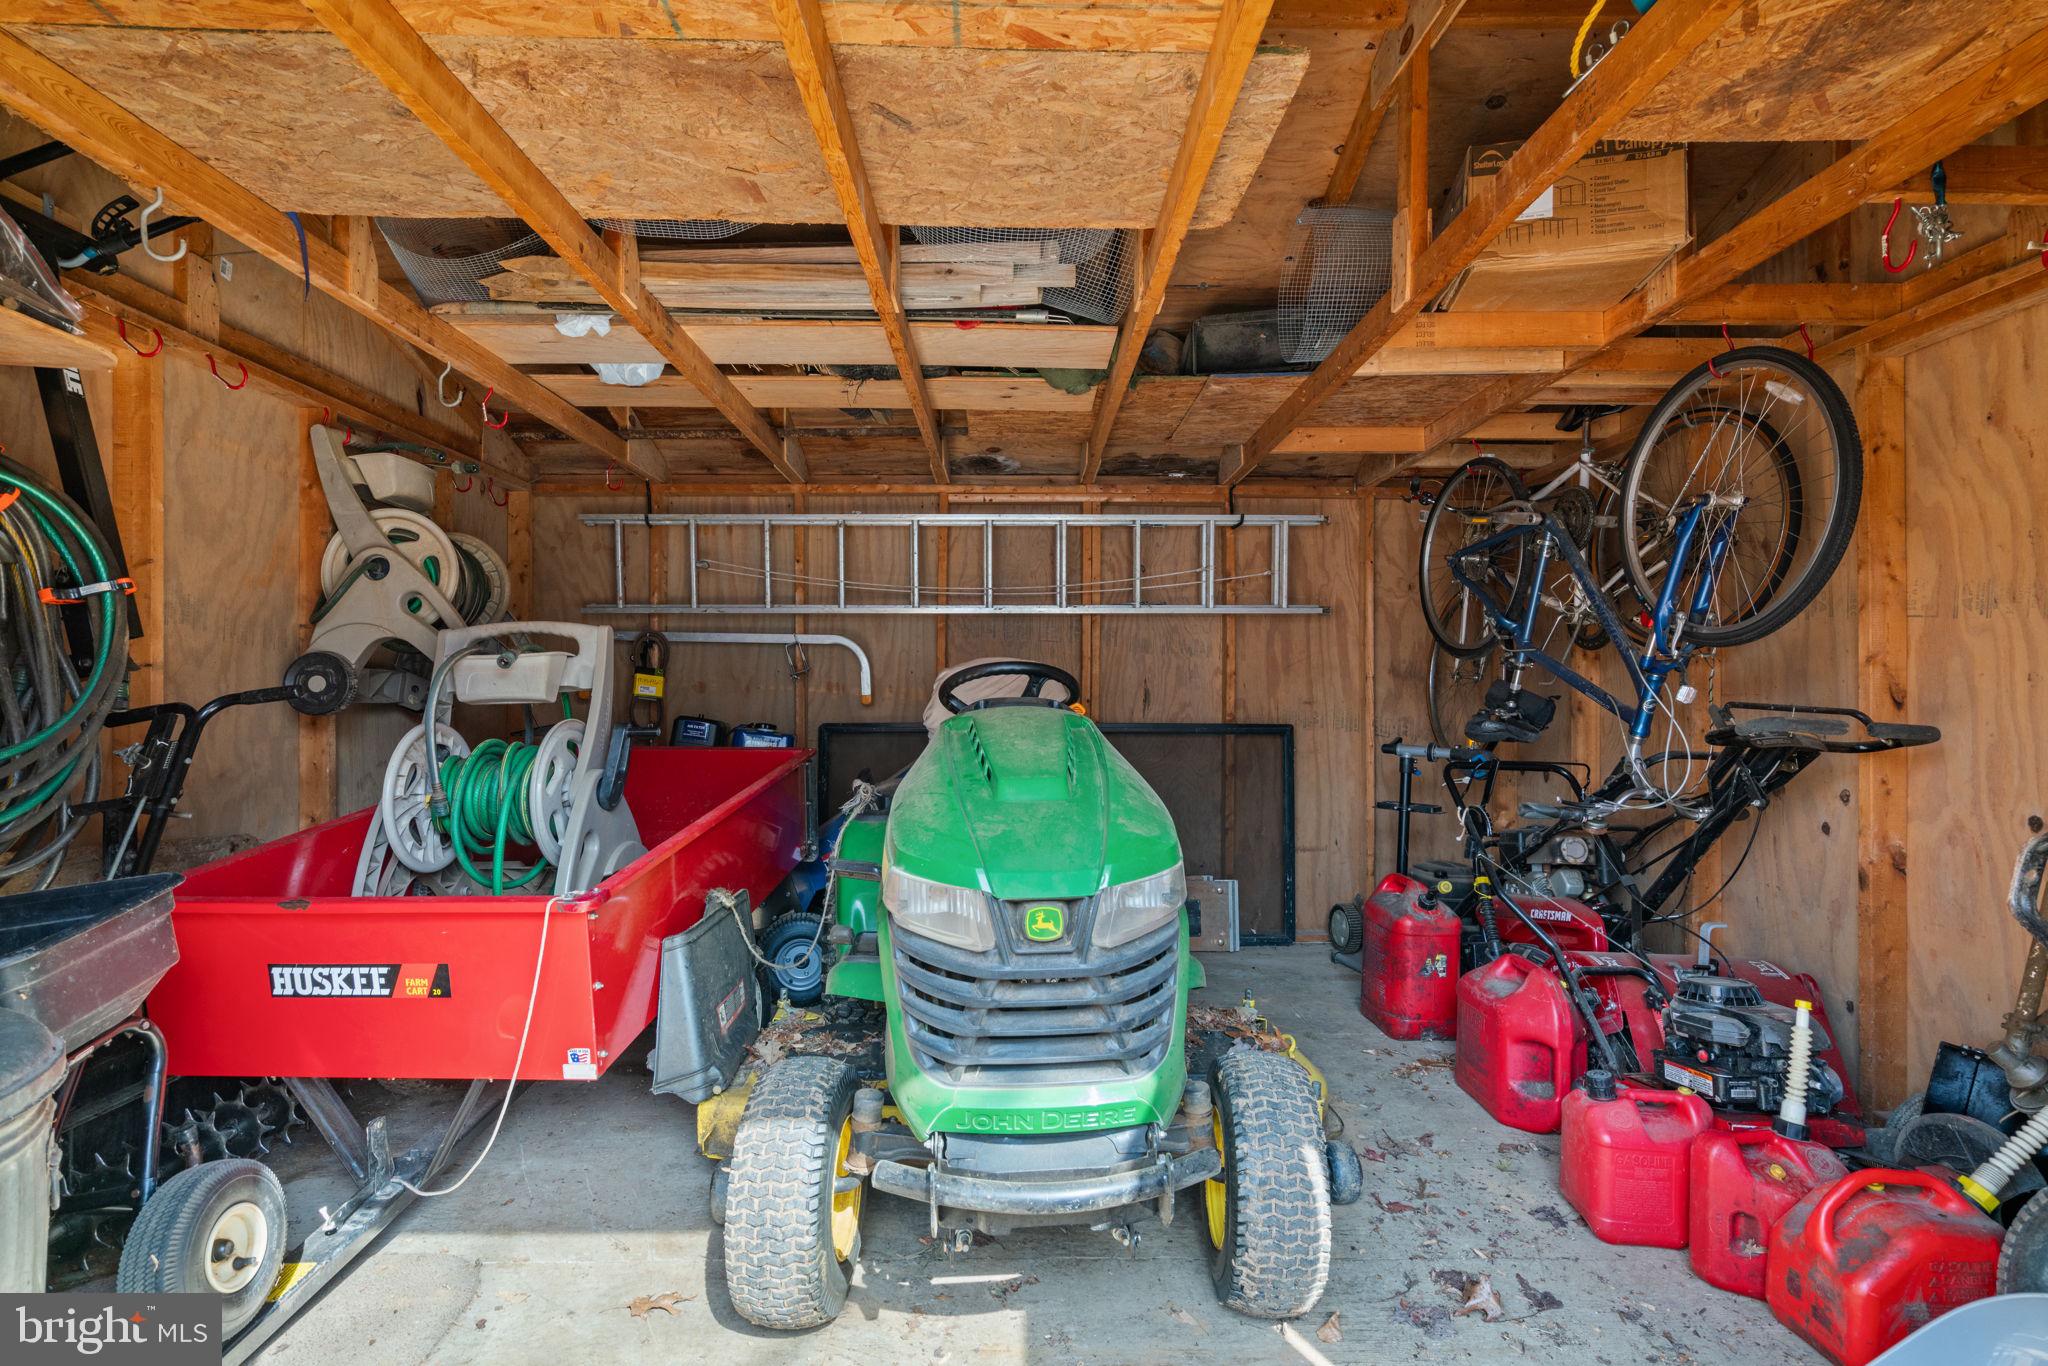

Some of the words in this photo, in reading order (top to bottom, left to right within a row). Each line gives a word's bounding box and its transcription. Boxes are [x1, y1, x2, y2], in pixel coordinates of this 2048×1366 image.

[1530, 908, 1572, 922] CRAFTSMAN
[270, 966, 391, 996] HUSKEE
[405, 978, 428, 987] FARM
[406, 987, 428, 996] CART
[432, 988, 441, 996] 20
[956, 1111, 1035, 1131] JOHN
[1041, 1106, 1136, 1131] DEERE
